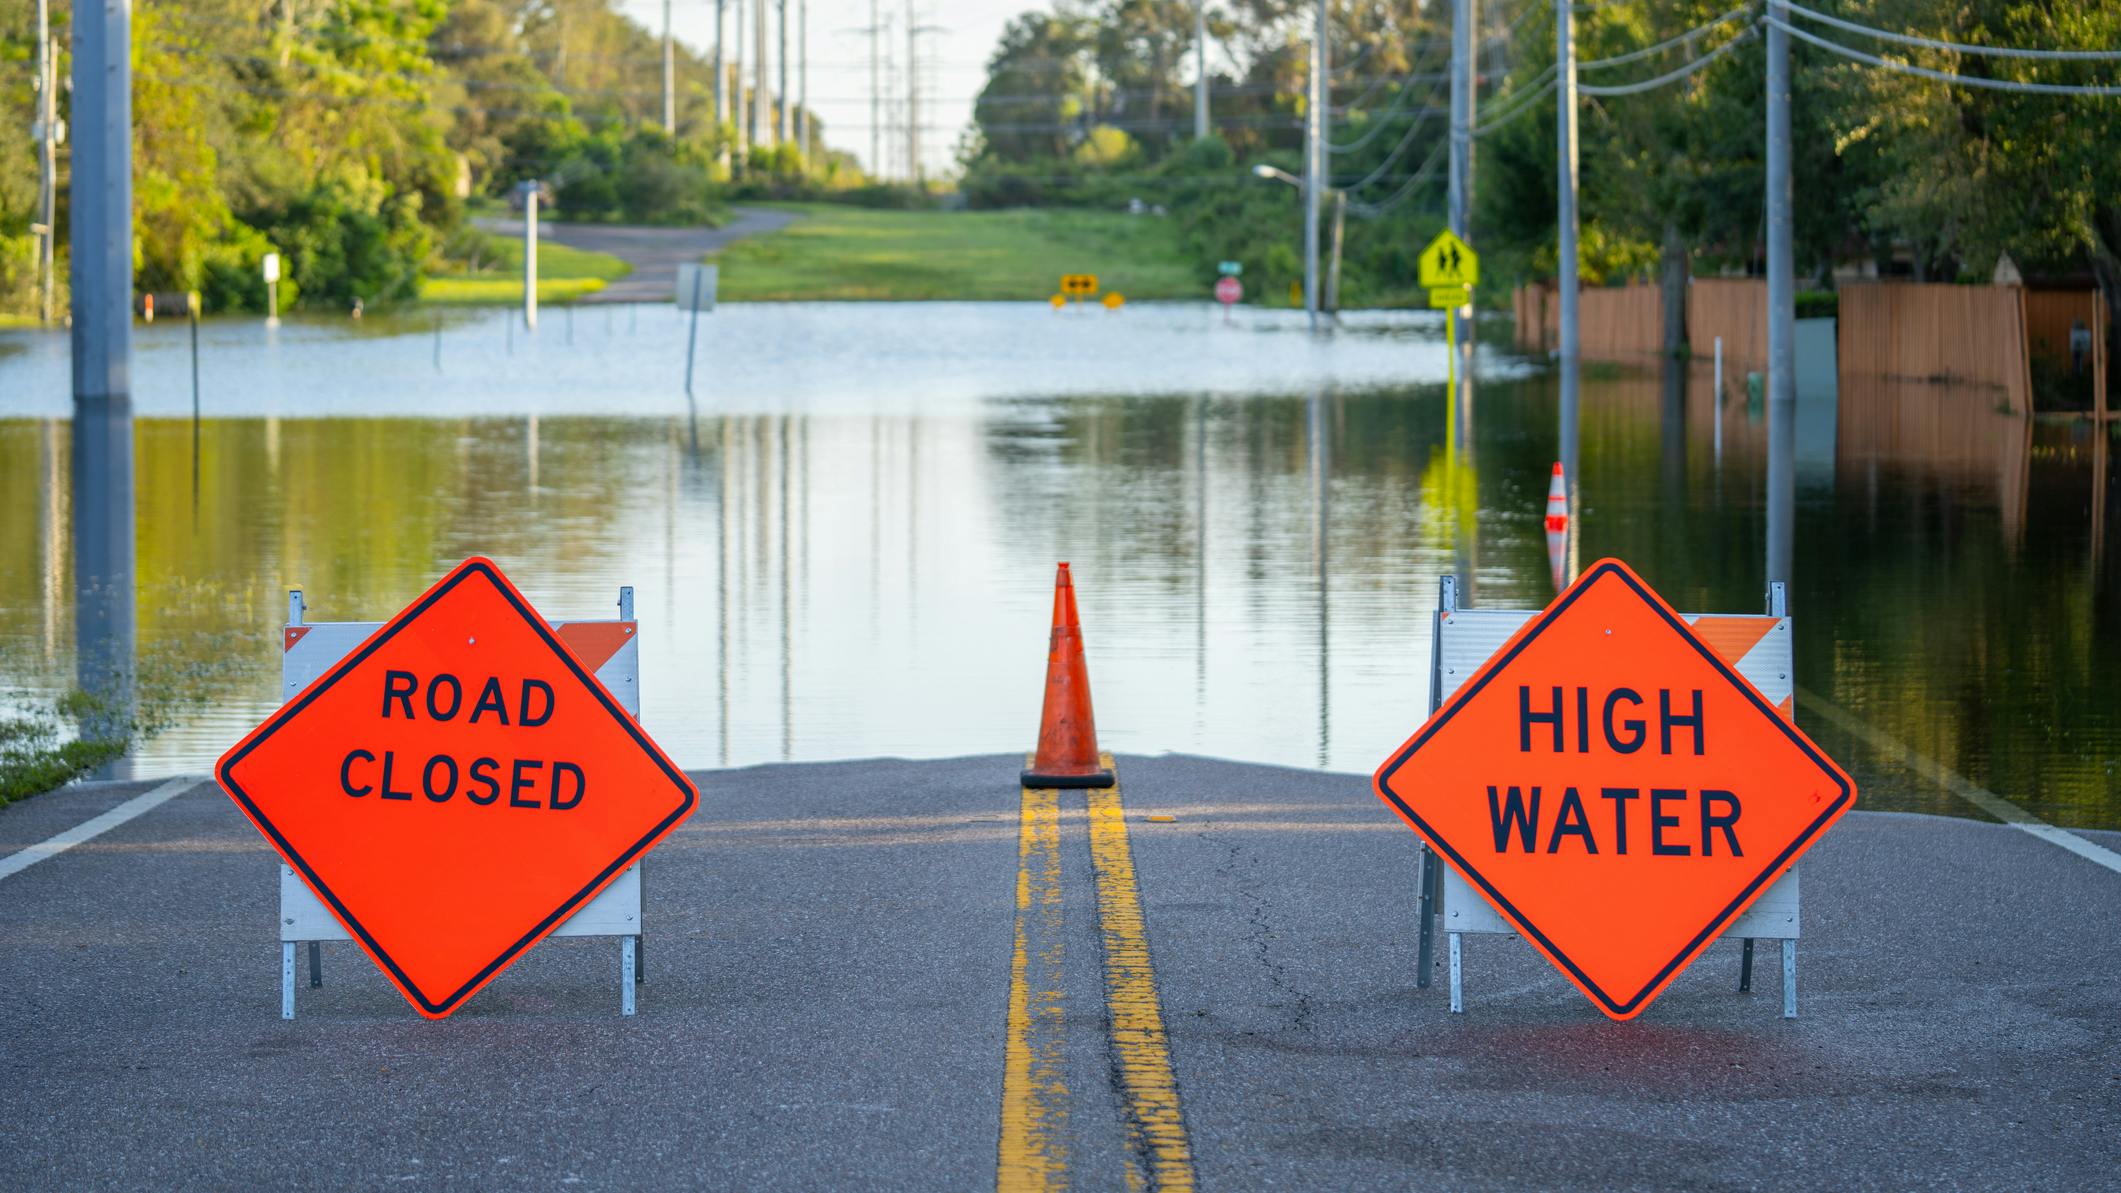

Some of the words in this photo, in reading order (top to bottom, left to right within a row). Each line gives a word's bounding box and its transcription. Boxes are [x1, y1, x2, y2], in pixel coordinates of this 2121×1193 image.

[382, 670, 555, 727] ROAD
[1520, 686, 1704, 755] HIGH
[340, 748, 586, 810] CLOSED
[1487, 785, 1743, 857] WATER
